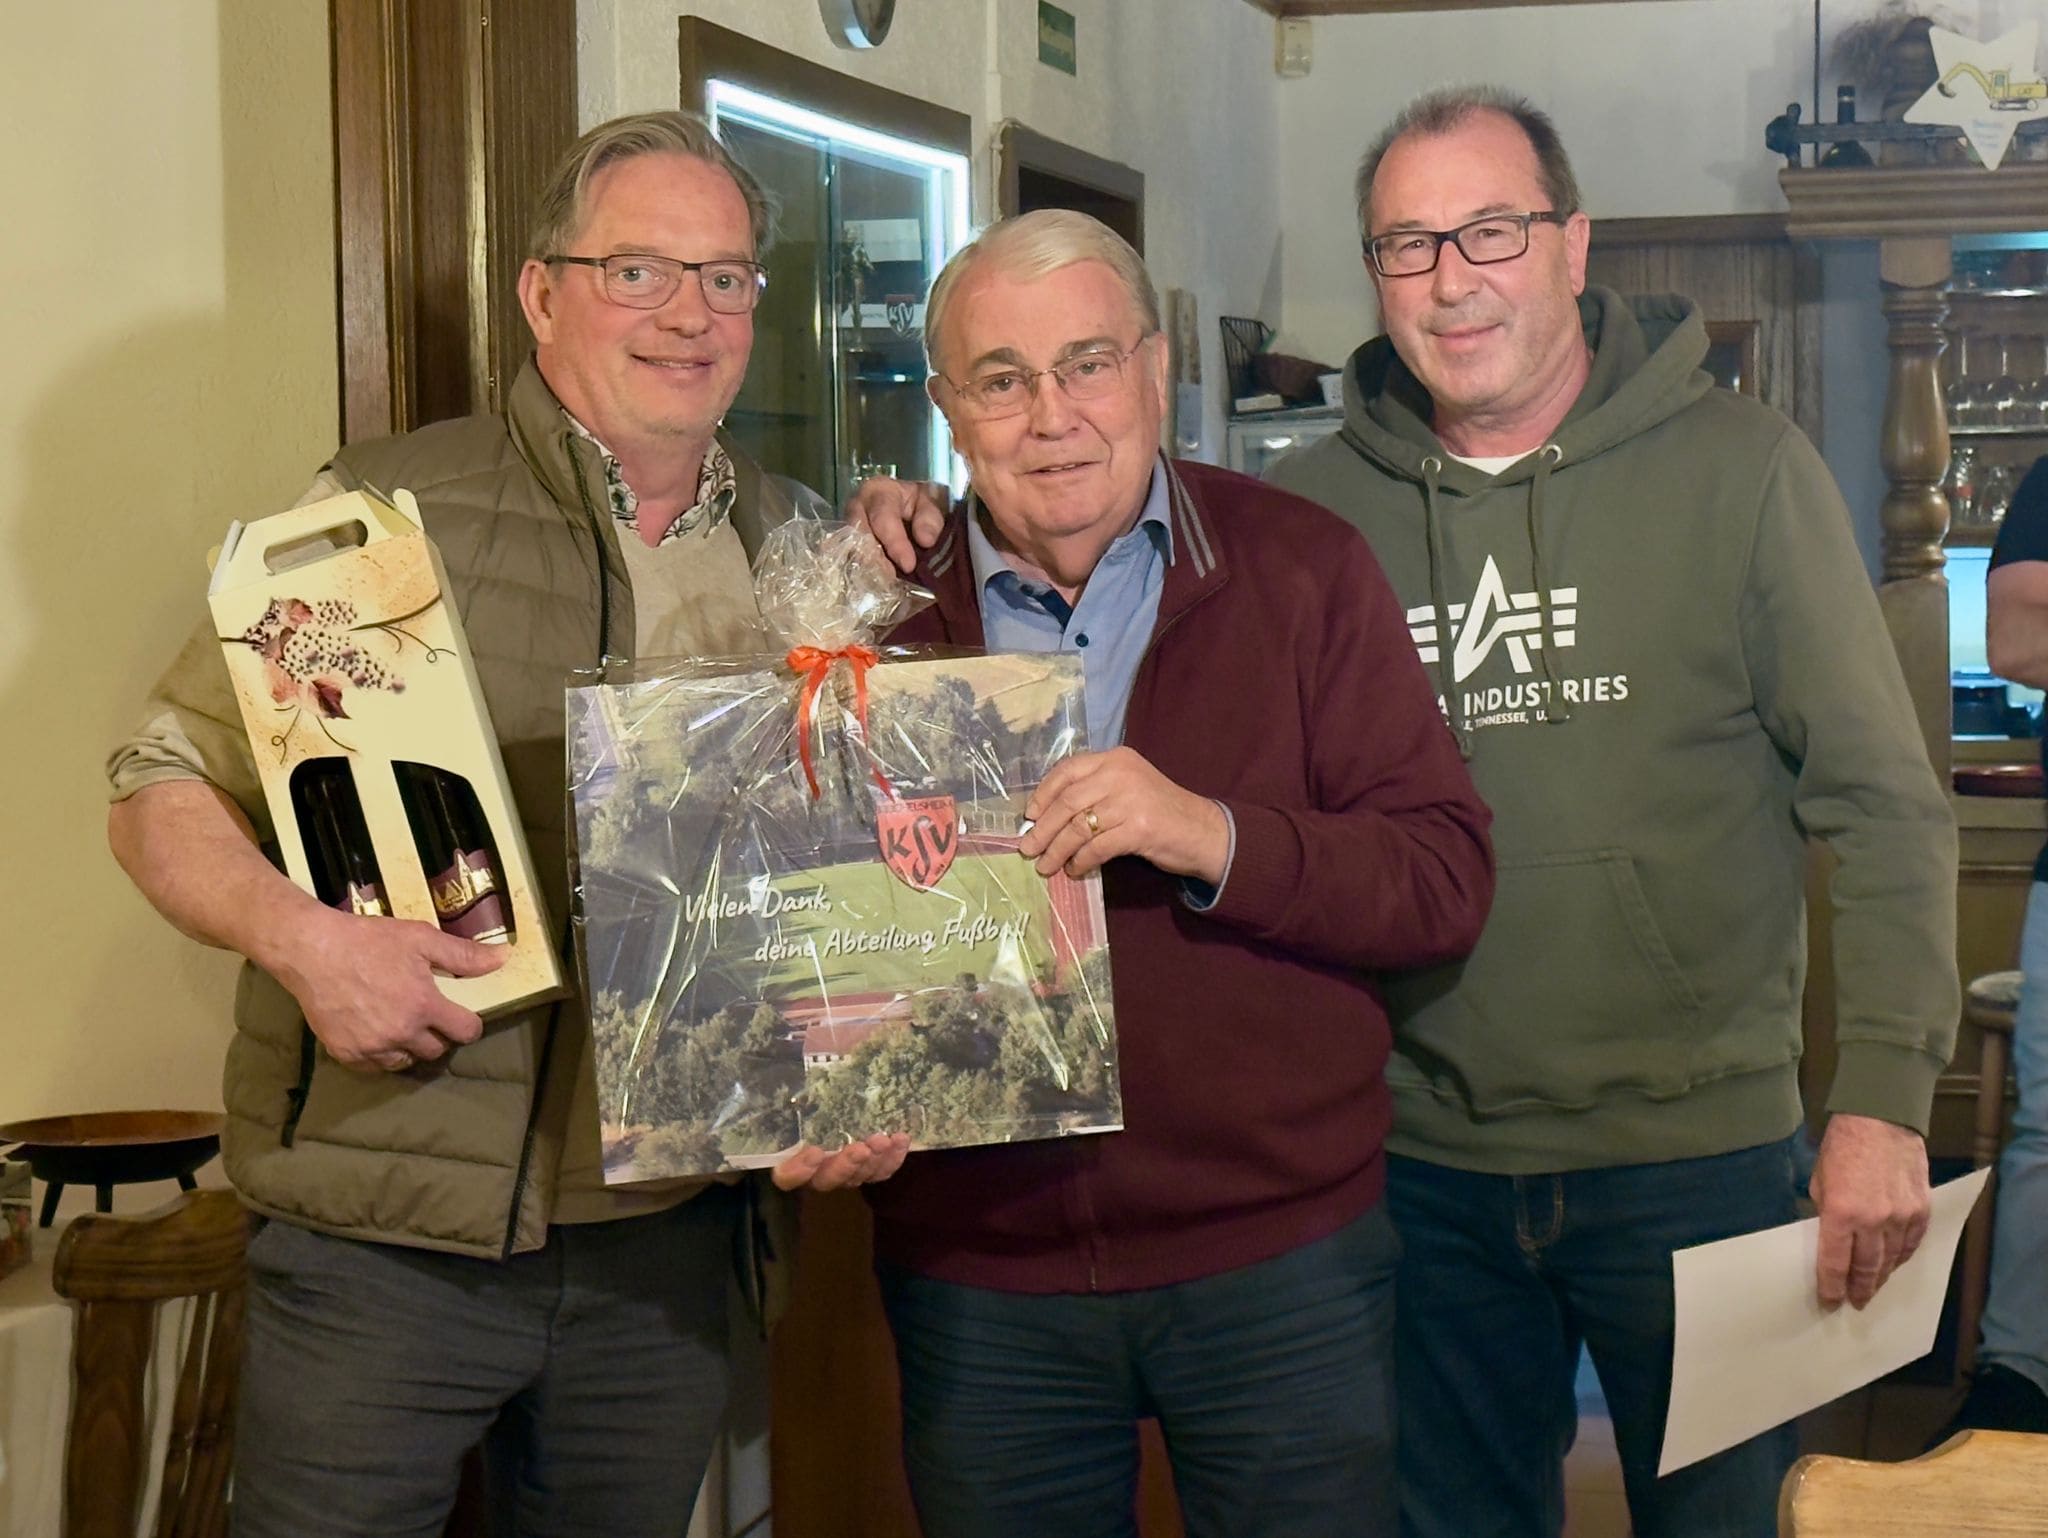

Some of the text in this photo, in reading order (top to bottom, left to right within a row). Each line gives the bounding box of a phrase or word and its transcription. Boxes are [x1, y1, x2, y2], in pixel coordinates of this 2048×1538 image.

[889, 303, 914, 332] KSV
[1464, 675, 1629, 716] INDUSTRIES
[887, 815, 953, 885] KSV
[686, 883, 832, 923] Vielen Dank,
[755, 911, 1030, 962] deine Abteilung Fußball
